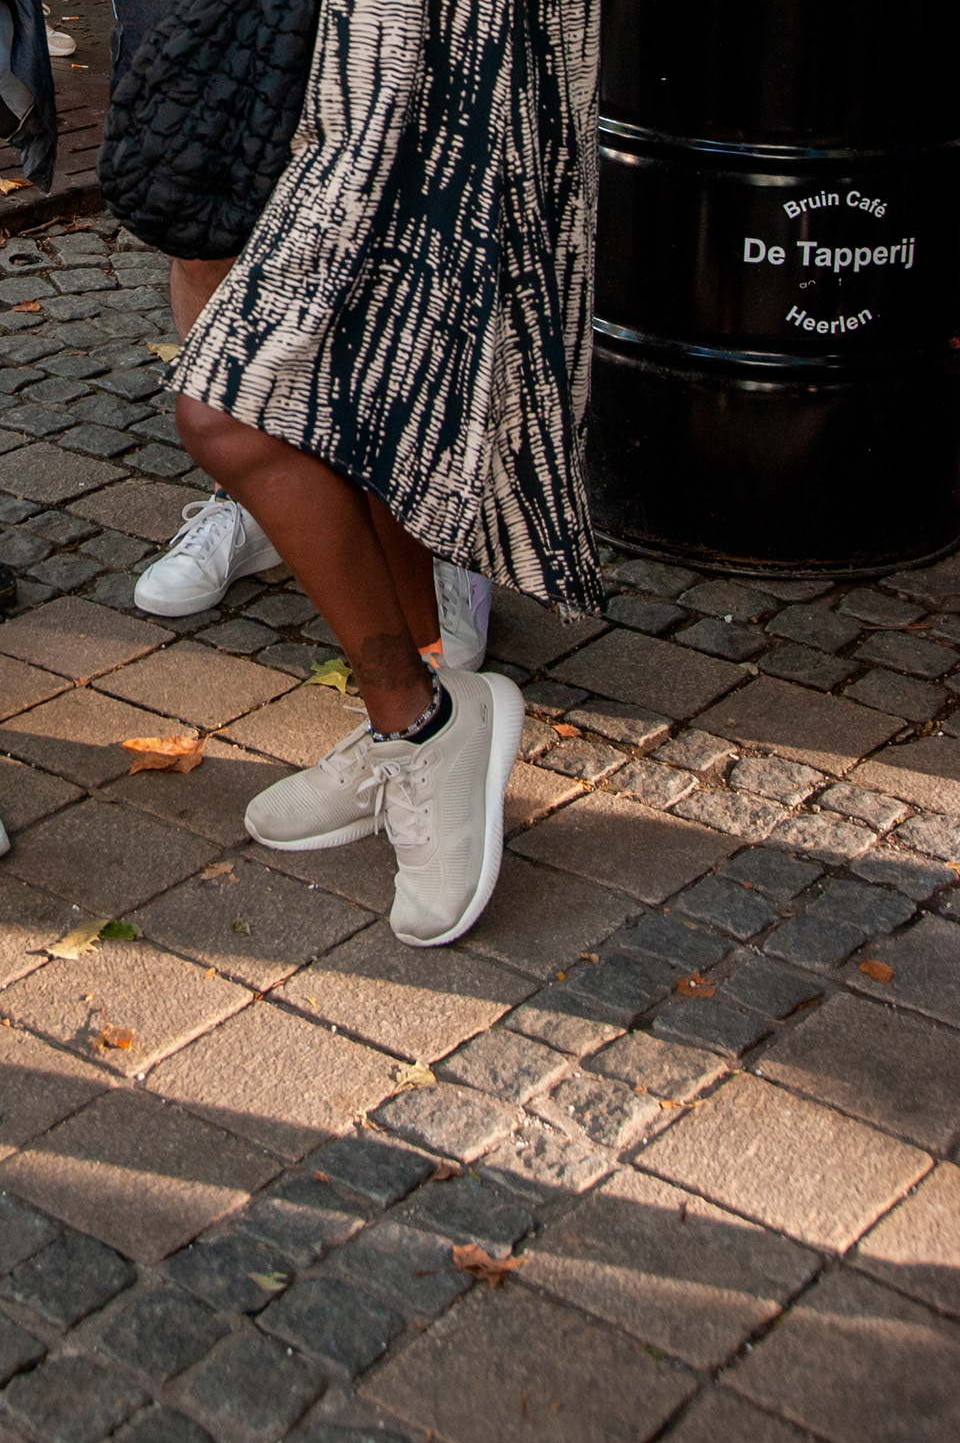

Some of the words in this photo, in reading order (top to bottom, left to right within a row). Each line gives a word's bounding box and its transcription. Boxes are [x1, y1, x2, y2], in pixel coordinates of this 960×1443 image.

[783, 190, 840, 219] Bruin
[846, 190, 888, 218] Café
[743, 237, 786, 265] De
[796, 237, 915, 273] Tapperij
[785, 305, 873, 334] Heerlen
